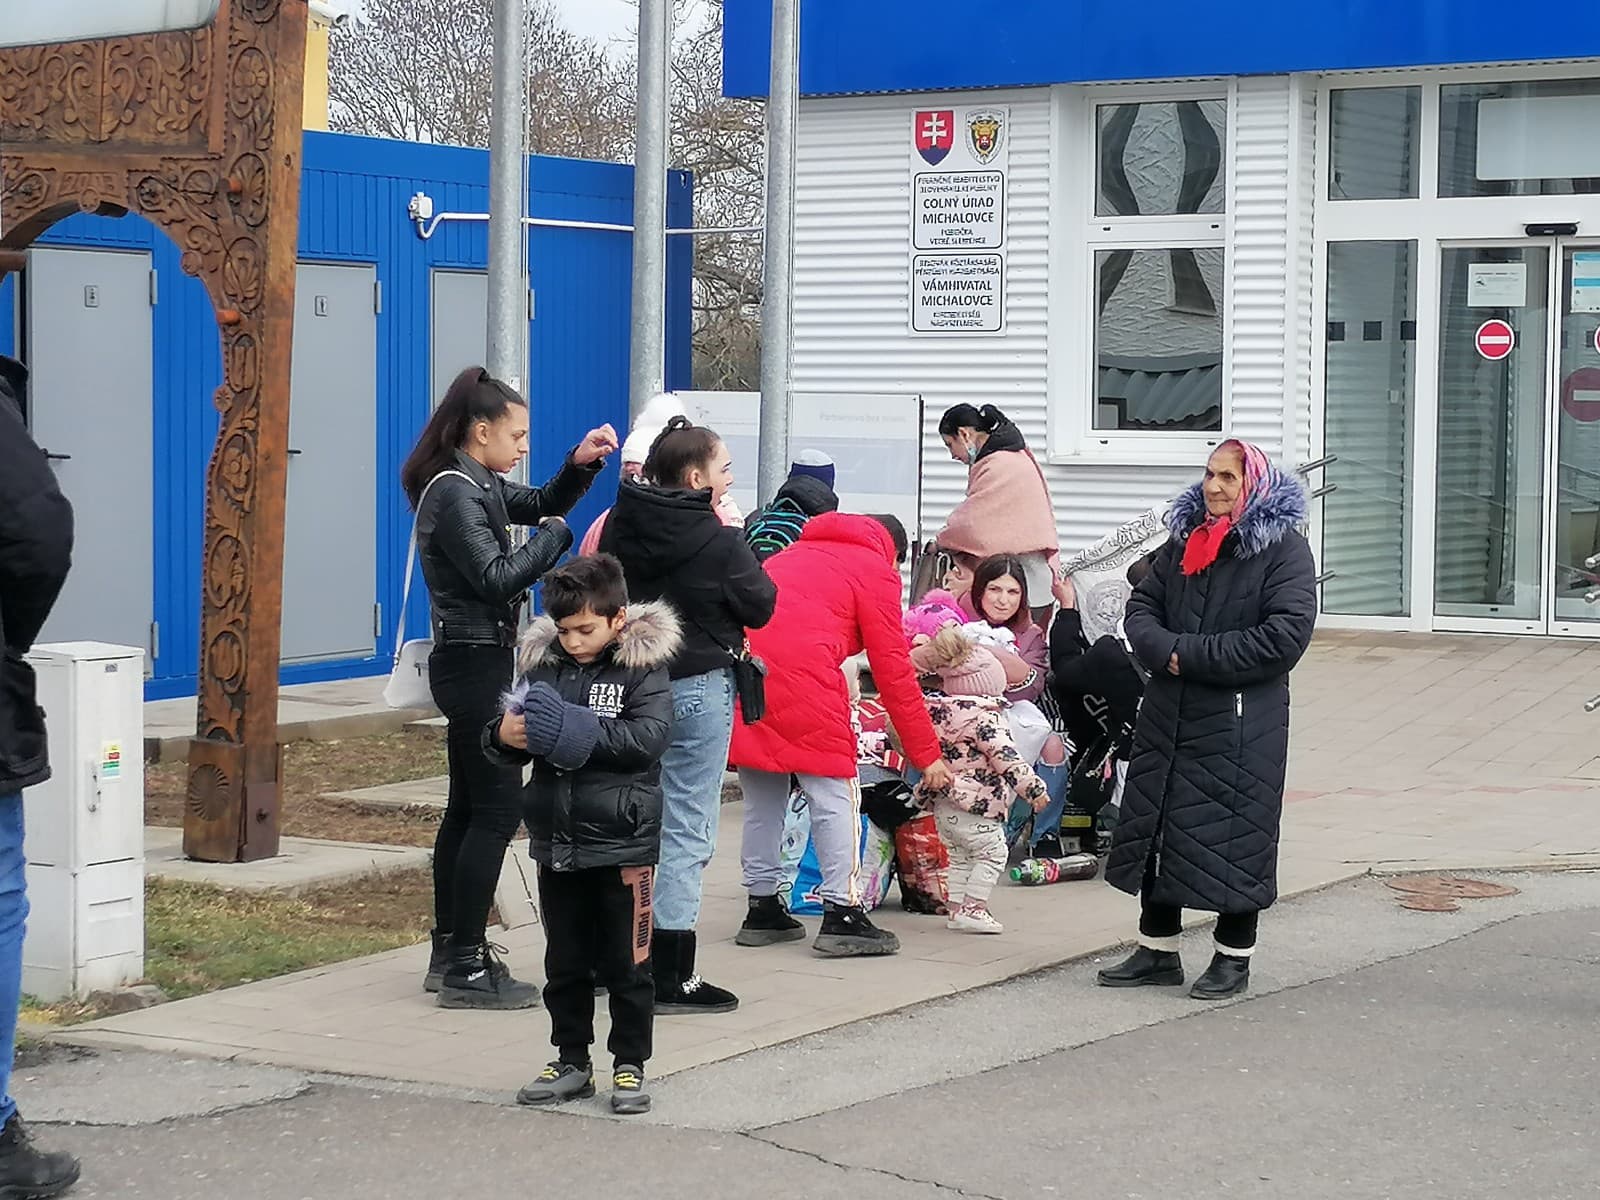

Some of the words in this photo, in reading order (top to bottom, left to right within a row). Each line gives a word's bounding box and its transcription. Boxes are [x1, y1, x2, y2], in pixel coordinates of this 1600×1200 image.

[923, 195, 959, 209] COLNÝ
[962, 194, 994, 208] ÚRAD
[922, 212, 995, 224] MICHALOVCE
[922, 278, 993, 291] VÁMHIVATAL
[921, 295, 994, 306] MICHALOVCE
[589, 683, 625, 696] STAY
[589, 694, 625, 708] REAL
